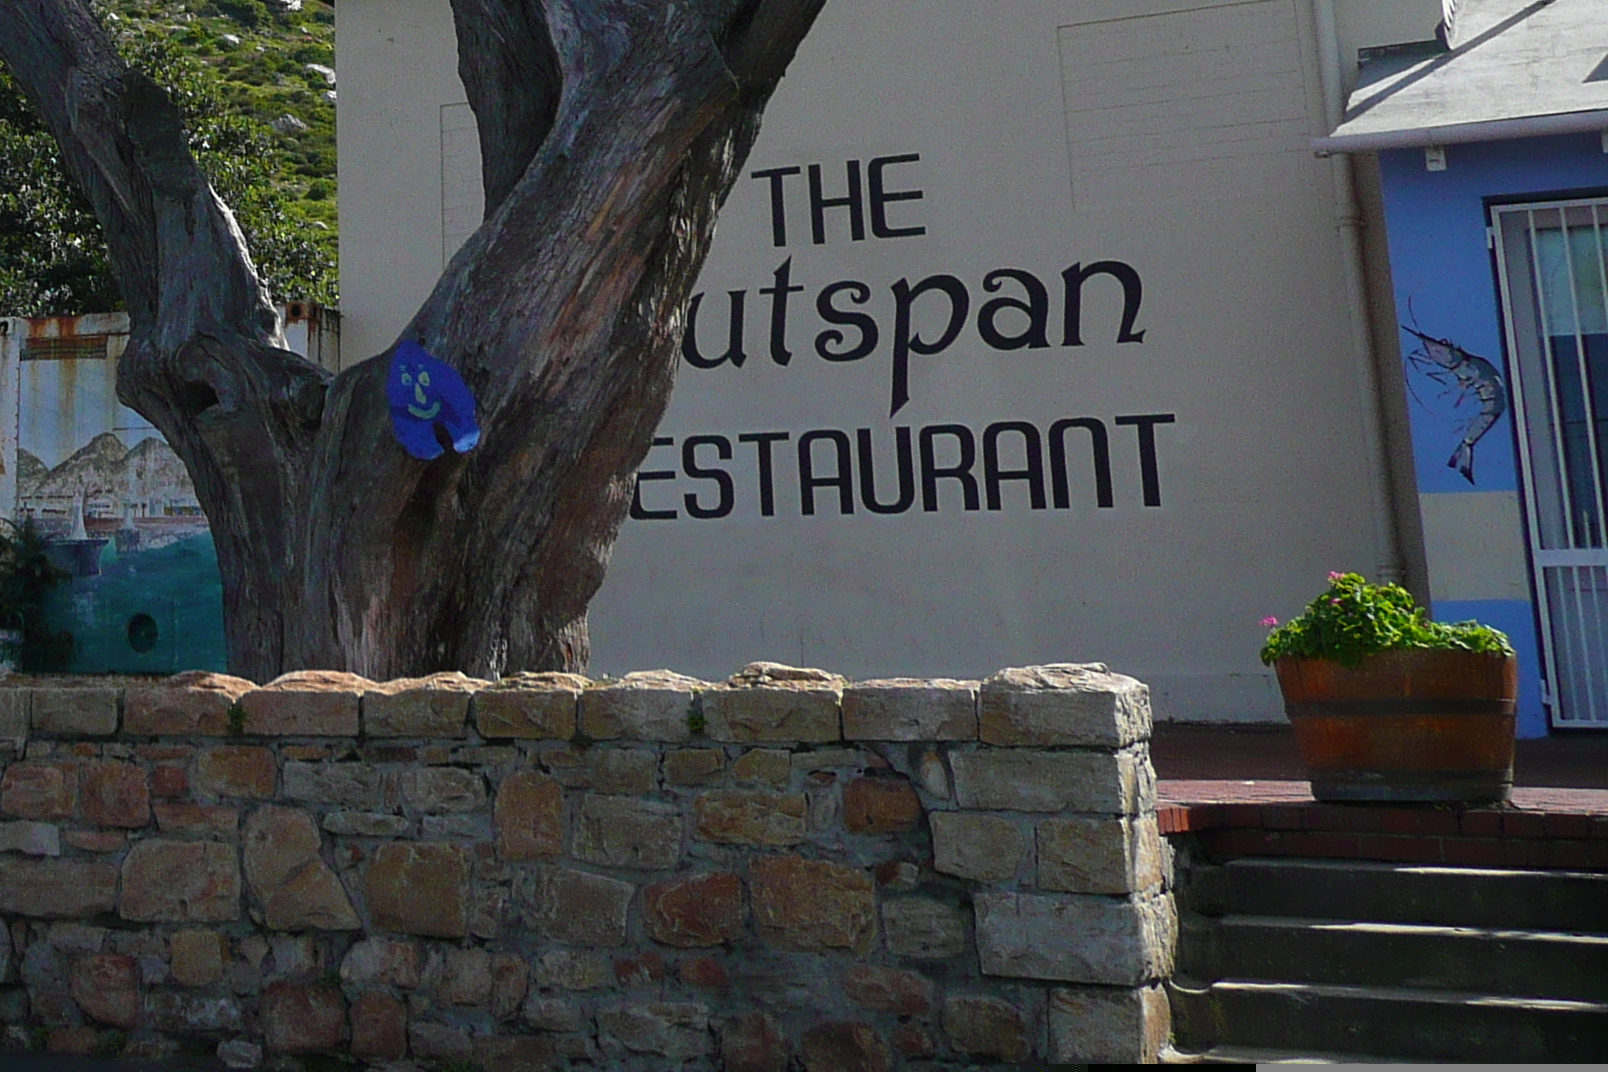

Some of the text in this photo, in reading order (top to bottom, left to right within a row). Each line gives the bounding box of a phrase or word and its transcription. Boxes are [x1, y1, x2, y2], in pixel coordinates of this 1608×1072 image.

[751, 153, 926, 248] THE
[681, 255, 1146, 419] utspan
[629, 414, 1175, 520] ESTAURANT
